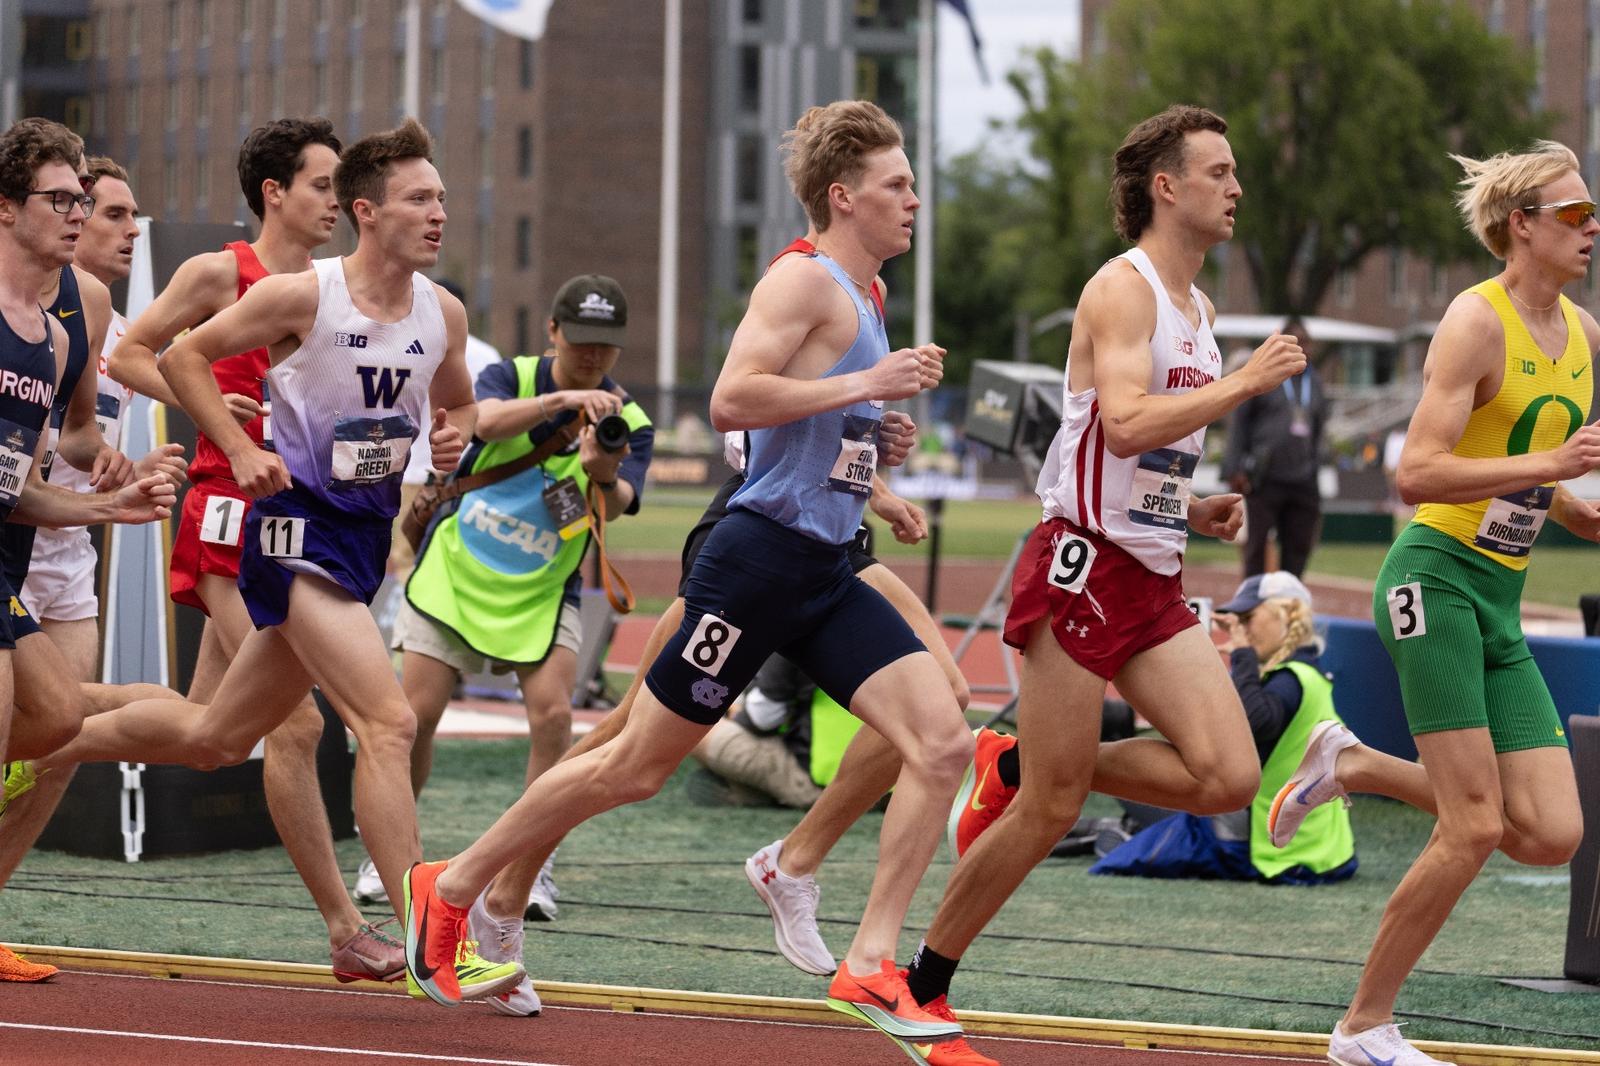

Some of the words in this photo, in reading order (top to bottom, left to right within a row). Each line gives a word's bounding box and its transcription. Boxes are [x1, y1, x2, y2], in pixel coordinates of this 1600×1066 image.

[356, 366, 412, 409] W
[355, 461, 391, 477] GREEN
[358, 446, 391, 460] NATHAN
[0, 471, 20, 492] RTIN
[216, 500, 232, 541] 1
[1142, 493, 1182, 516] SPENCER
[1507, 511, 1536, 527] SIMEON
[266, 519, 293, 555] 11
[463, 499, 559, 561] NCAA
[1487, 521, 1537, 545] BIRNBAUM
[1053, 539, 1089, 585] 9
[1395, 587, 1417, 636] 3
[692, 621, 730, 668] 8
